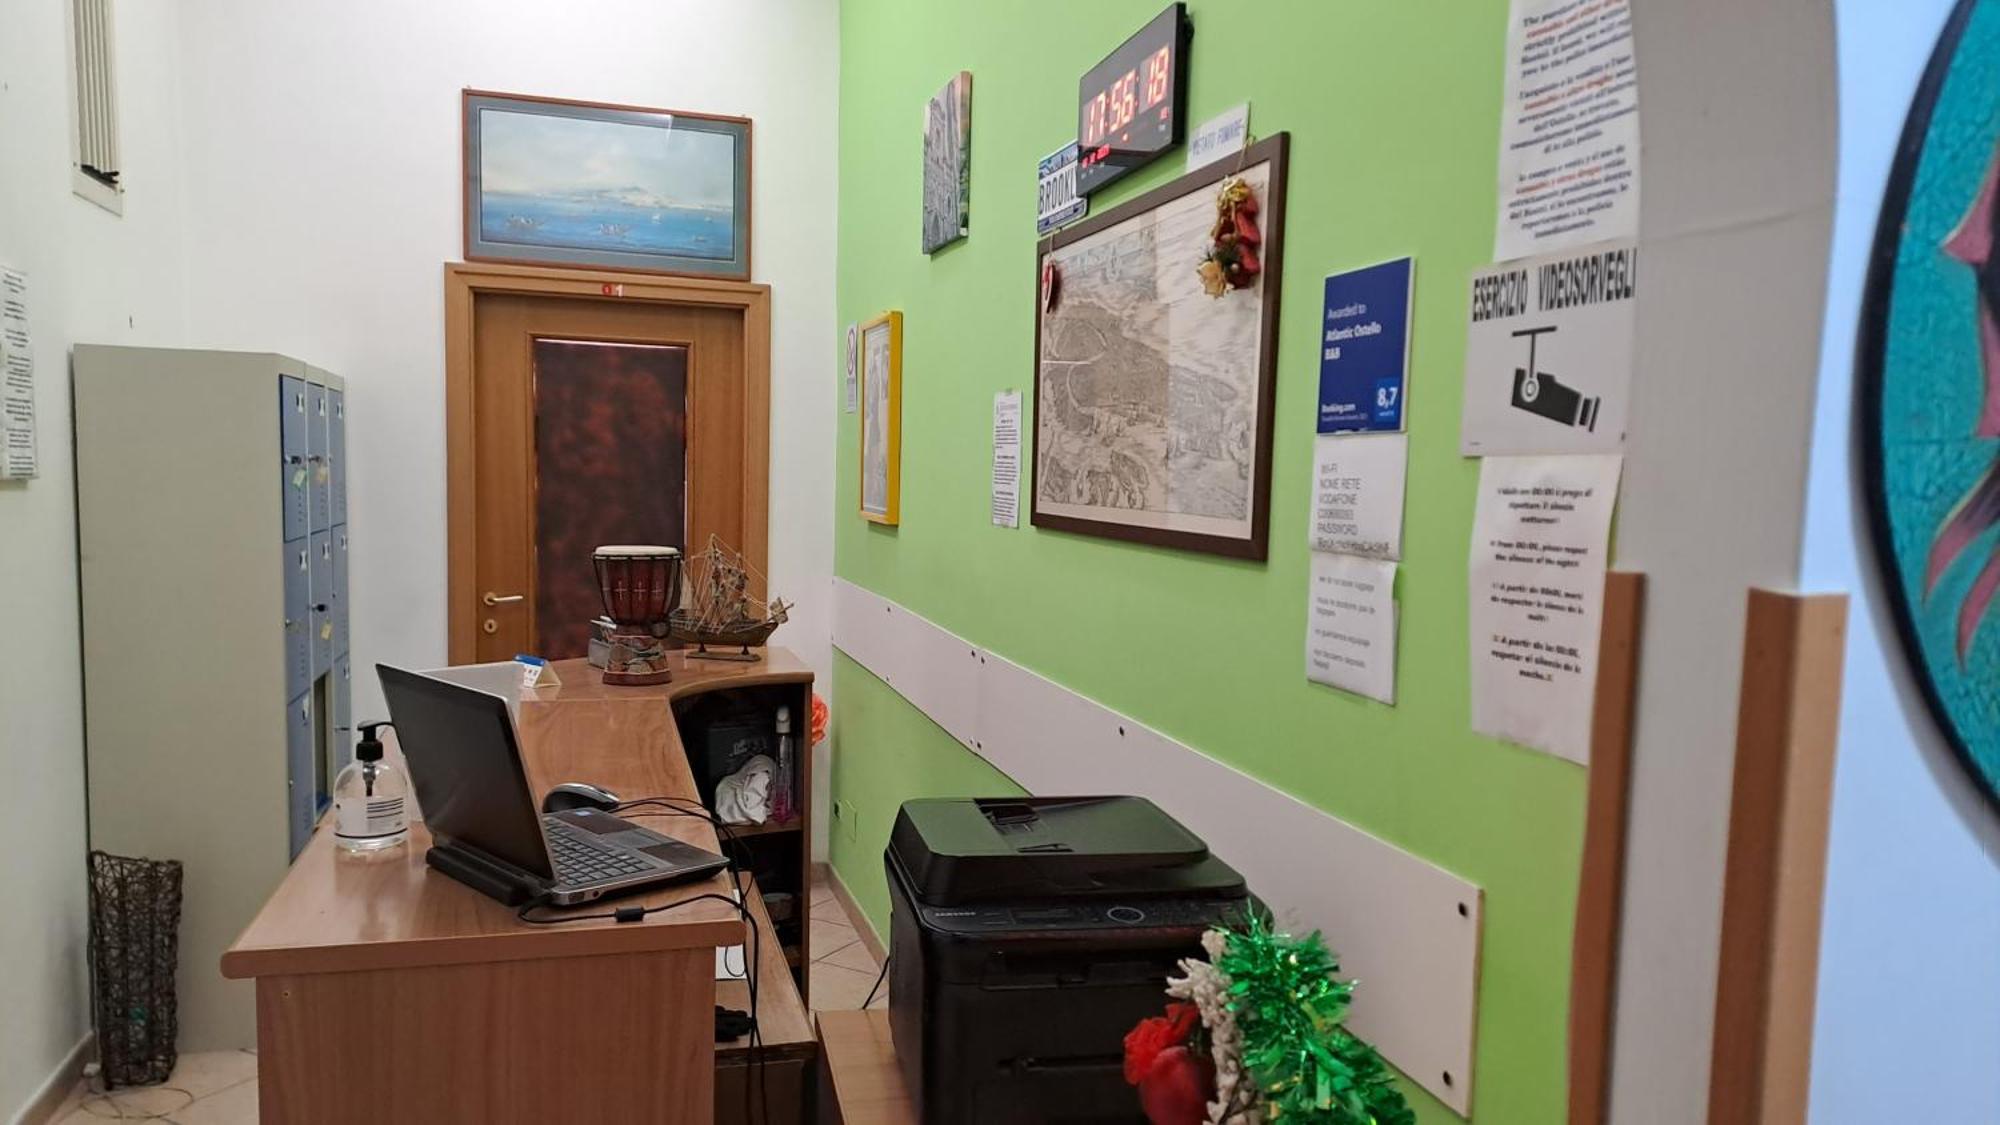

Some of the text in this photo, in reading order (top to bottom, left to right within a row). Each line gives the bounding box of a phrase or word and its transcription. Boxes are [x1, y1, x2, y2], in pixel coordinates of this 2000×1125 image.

[1038, 165, 1075, 215] BROOKL
[1472, 268, 1529, 322] ESERCIZIO
[1325, 321, 1382, 342] Atlantic Ostello
[1377, 386, 1399, 408] 8,7
